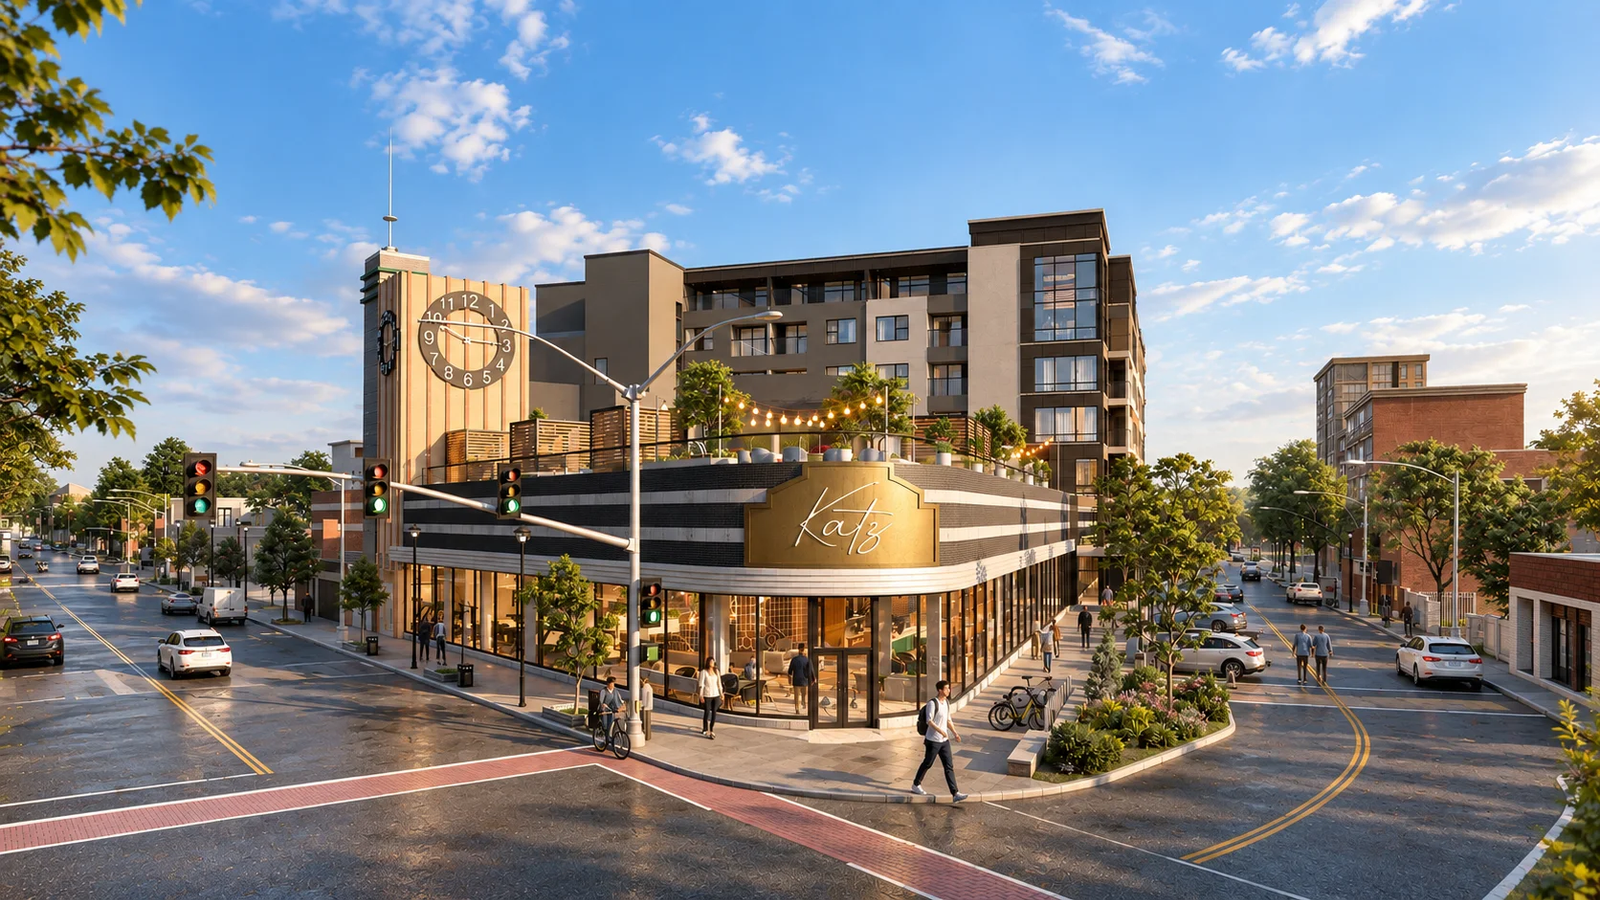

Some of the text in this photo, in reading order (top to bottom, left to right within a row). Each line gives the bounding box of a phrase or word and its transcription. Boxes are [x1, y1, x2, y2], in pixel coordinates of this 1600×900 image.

[440, 297, 454, 310] 11
[462, 294, 479, 309] 12
[489, 303, 495, 318] 1
[501, 318, 509, 333] 2
[424, 330, 434, 345] 9
[502, 338, 511, 352] 3
[430, 352, 438, 365] 7
[496, 358, 505, 371] 4
[444, 366, 453, 379] 8
[482, 370, 491, 384] 5
[463, 373, 473, 387] 6
[795, 481, 894, 555] Katz
